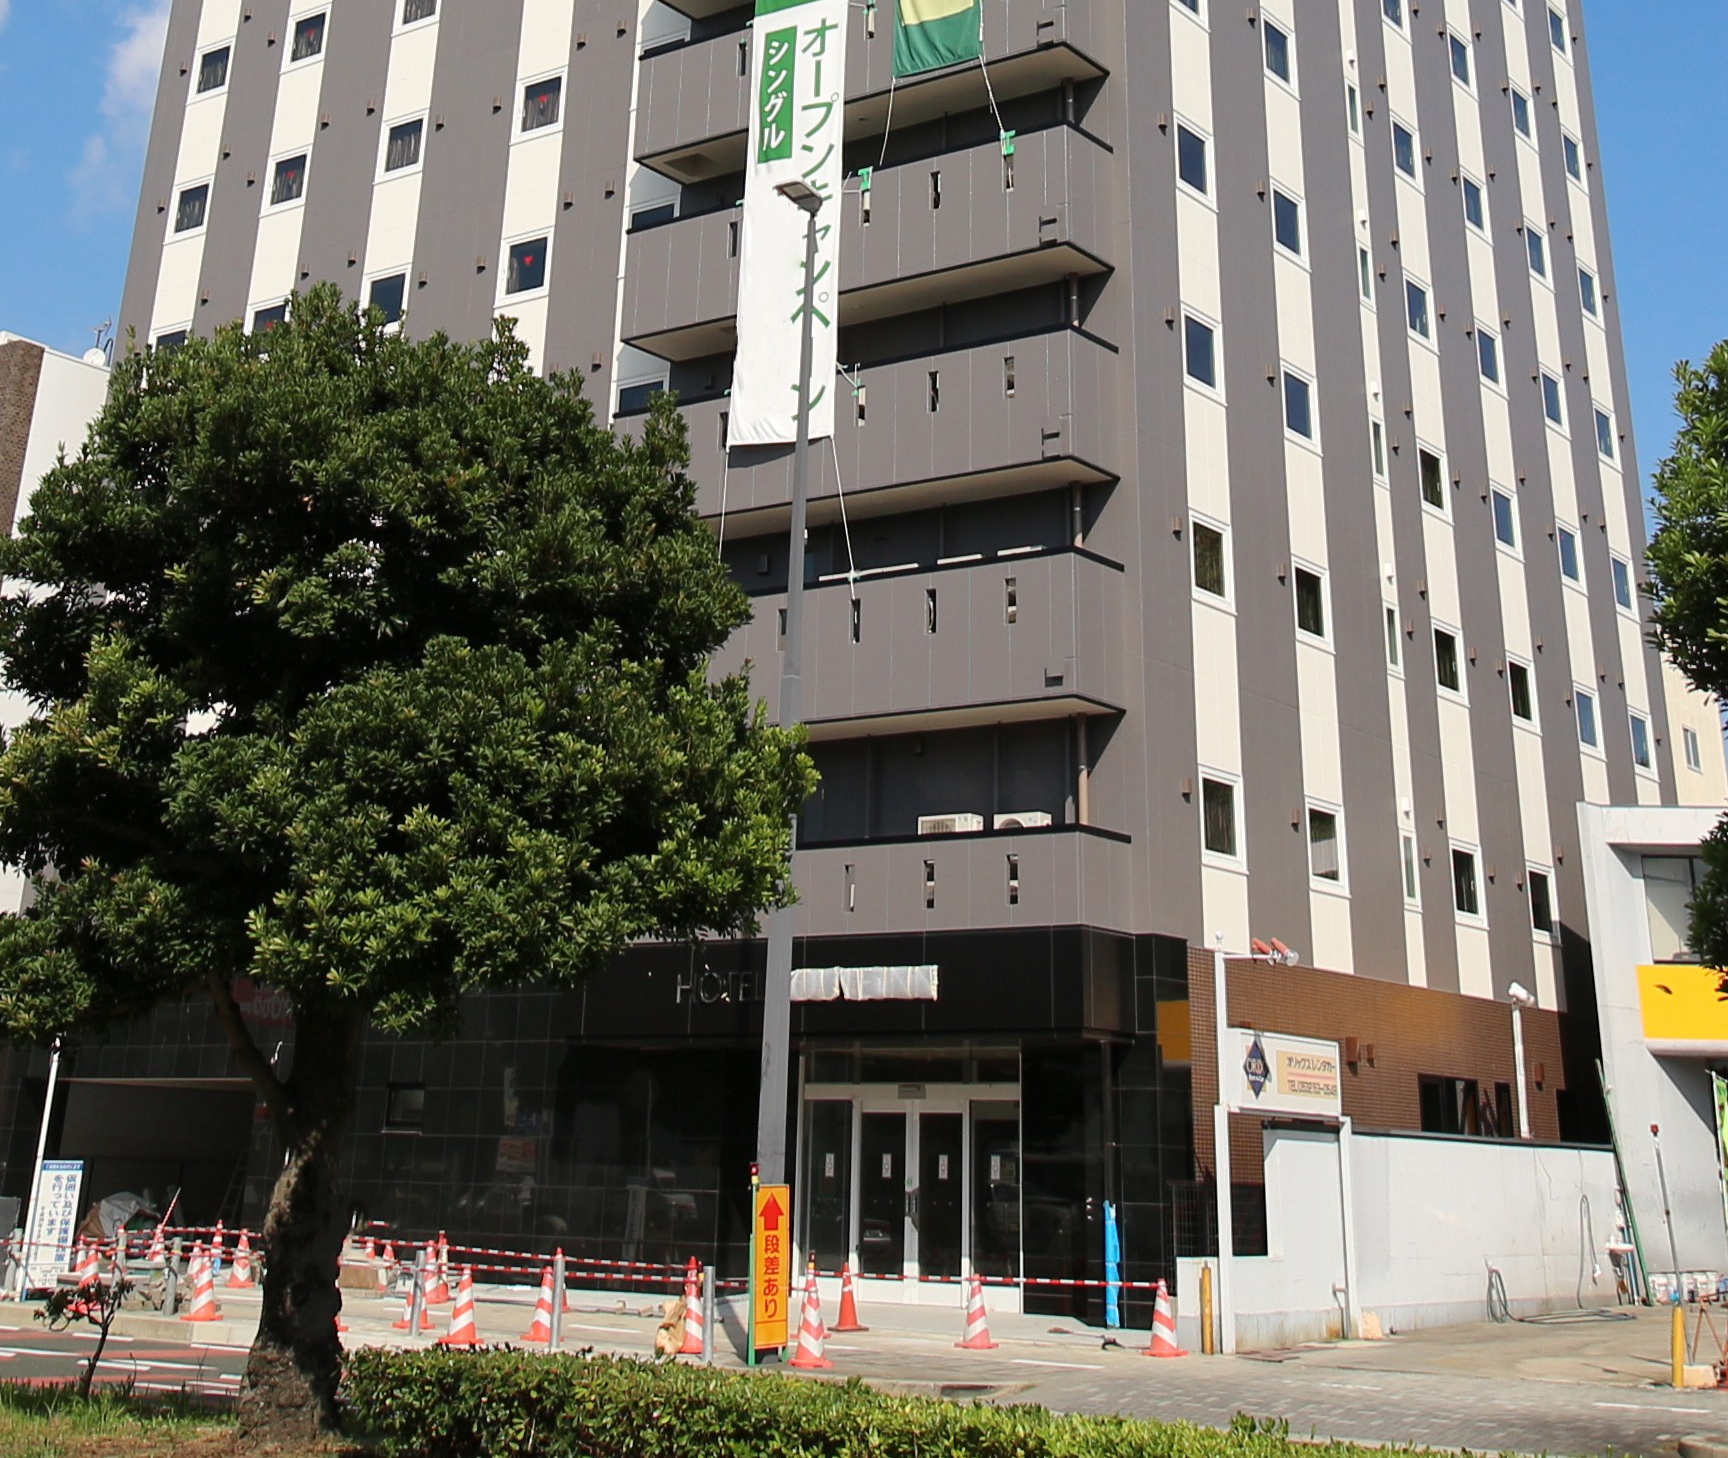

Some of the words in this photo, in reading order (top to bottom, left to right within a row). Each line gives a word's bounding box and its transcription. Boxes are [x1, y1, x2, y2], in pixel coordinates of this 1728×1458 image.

[763, 41, 789, 152] シングル
[1287, 1056, 1336, 1073] オリックスレンタカー
[763, 1234, 779, 1319] 段差あり
